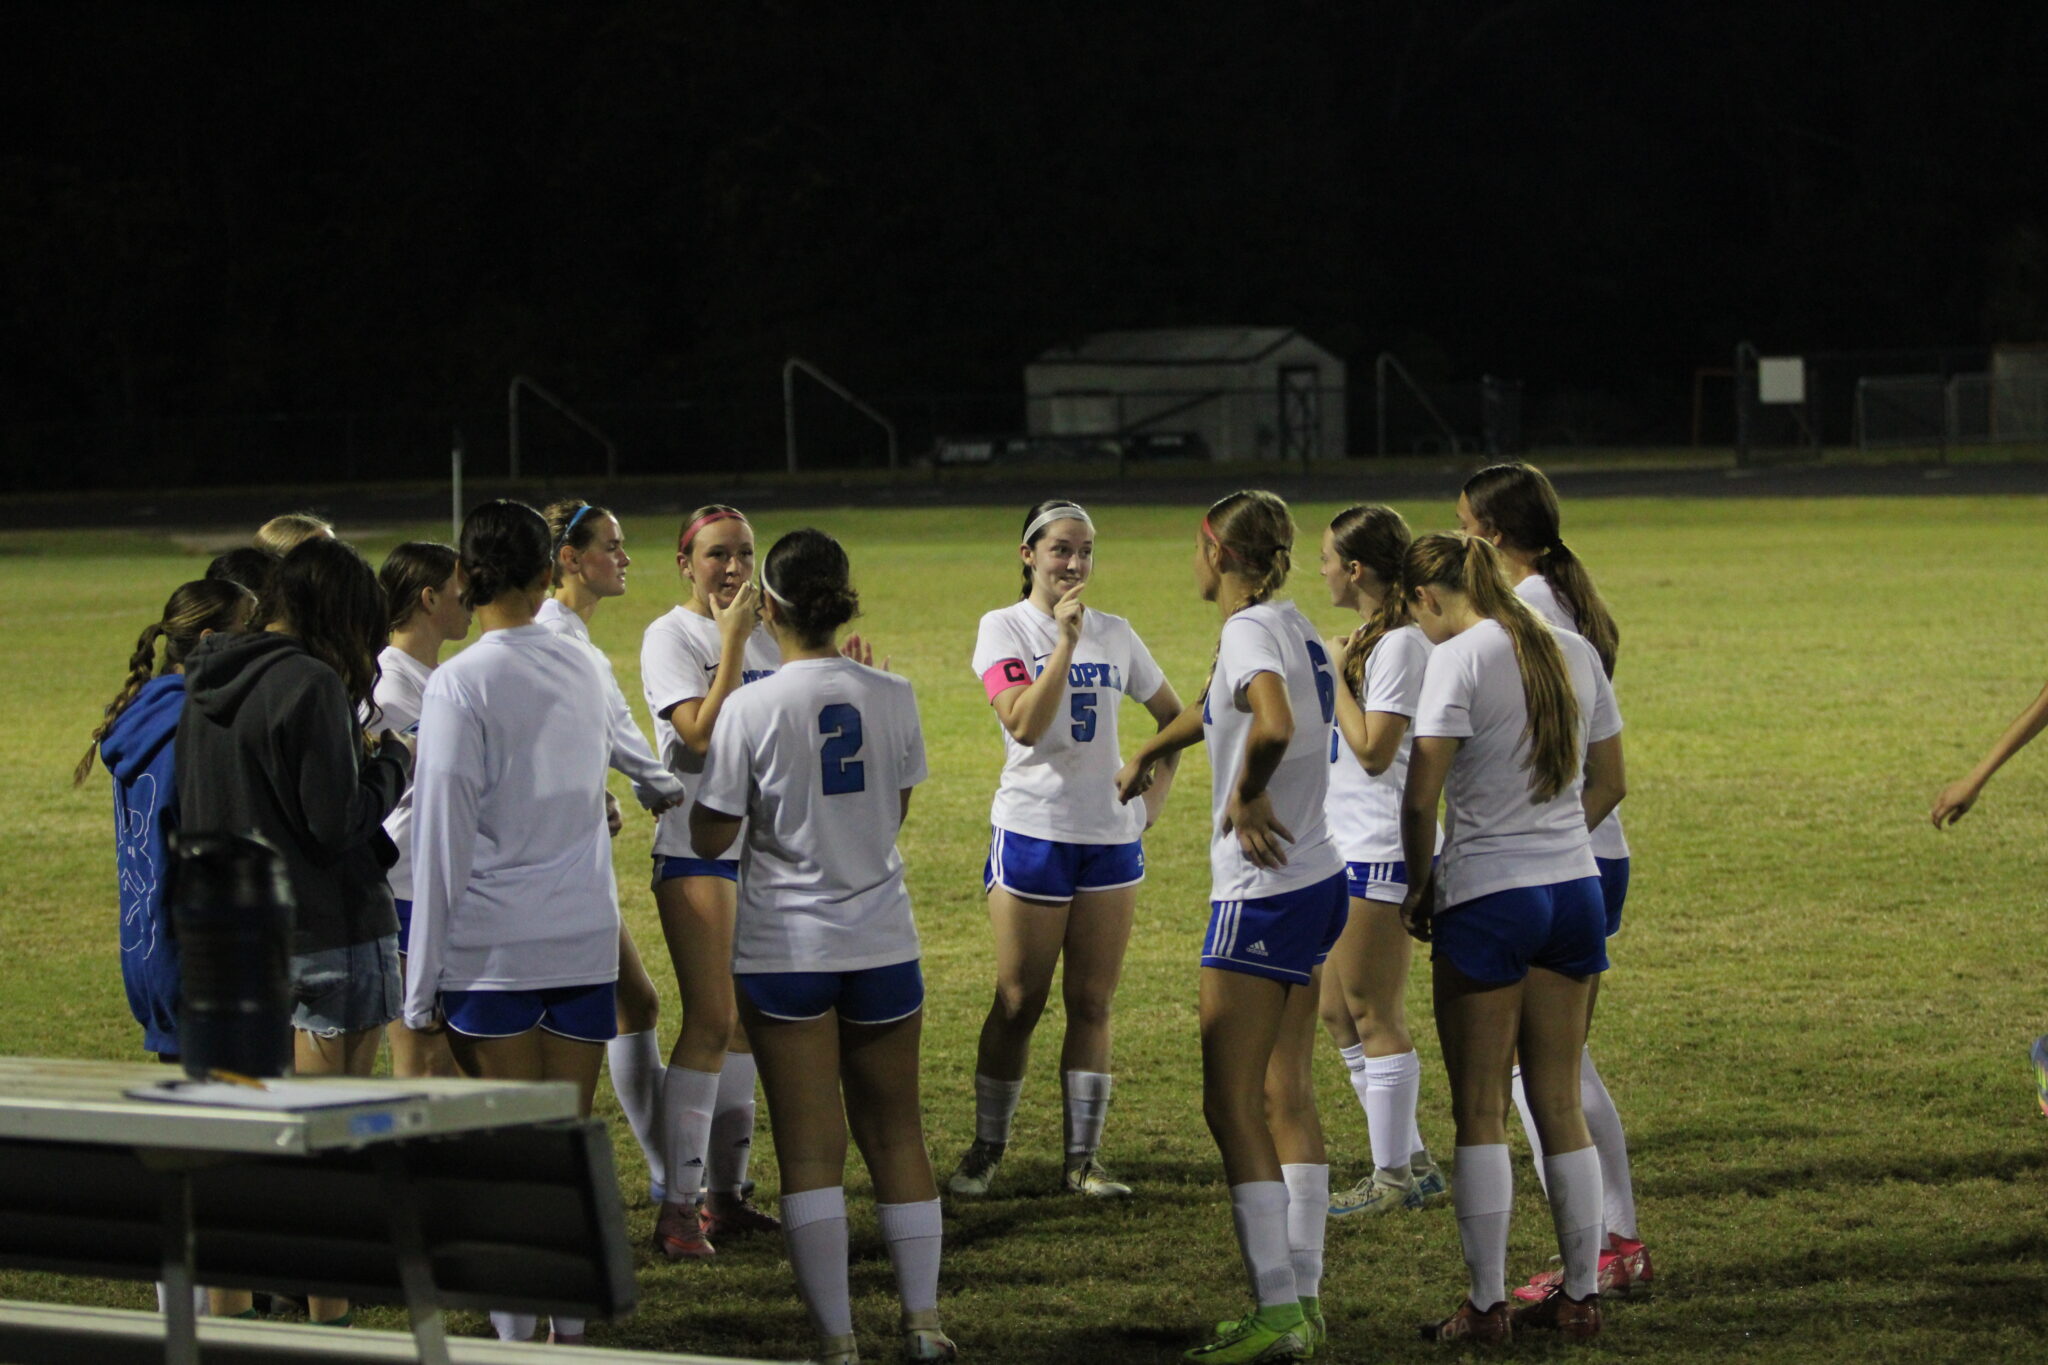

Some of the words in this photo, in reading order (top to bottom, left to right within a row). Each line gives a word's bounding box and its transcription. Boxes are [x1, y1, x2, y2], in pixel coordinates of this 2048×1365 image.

[1003, 663, 1025, 682] C
[1305, 640, 1335, 724] 6
[818, 703, 865, 796] 2
[1071, 693, 1097, 742] 5
